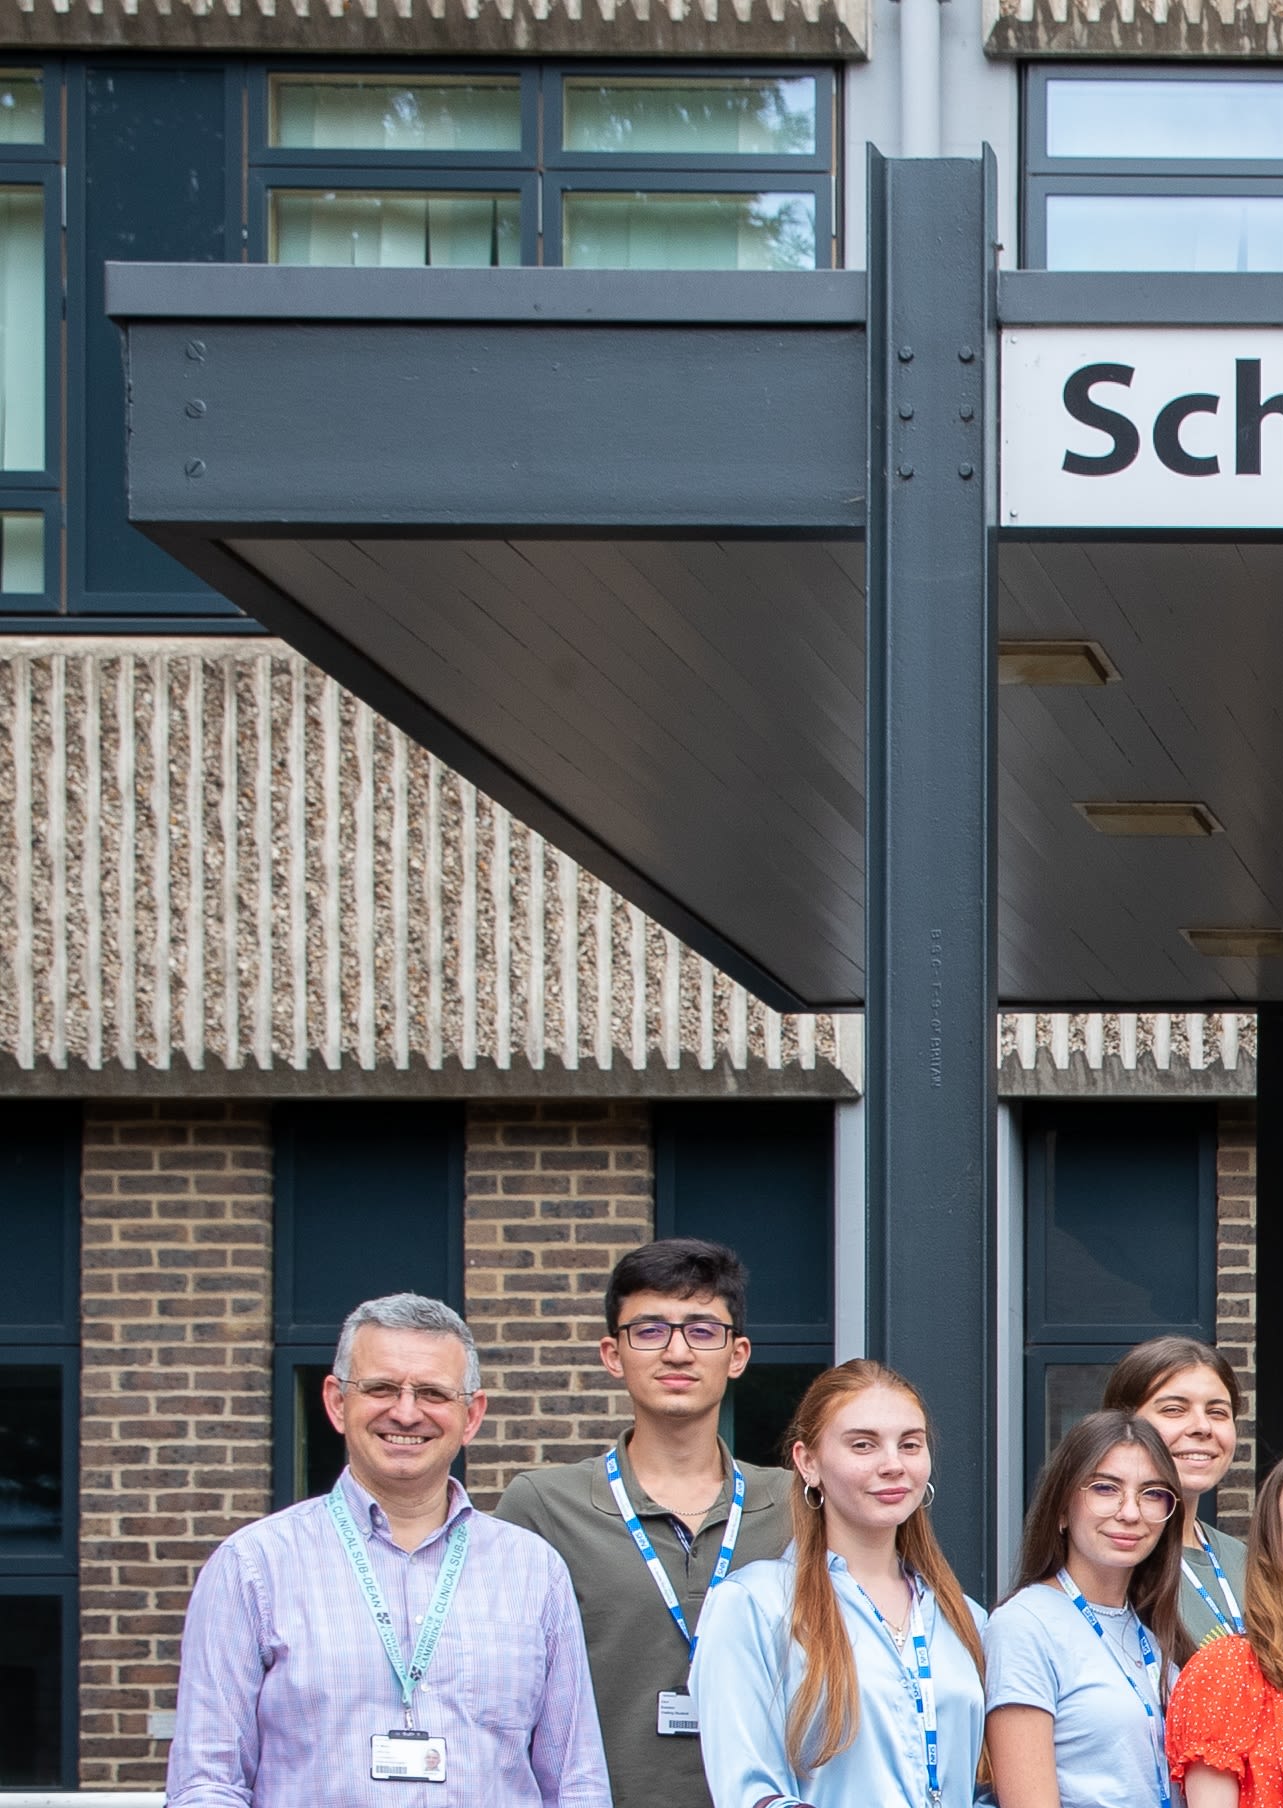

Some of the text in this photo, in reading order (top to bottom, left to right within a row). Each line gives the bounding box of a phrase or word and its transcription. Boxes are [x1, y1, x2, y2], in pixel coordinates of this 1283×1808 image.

[331, 1504, 359, 1550] CLINICAL
[351, 1550, 382, 1609] SUB-DEAN
[632, 1529, 648, 1548] NHS
[434, 1524, 467, 1614] CLINICAL SUB-DE
[716, 1558, 727, 1576] NHS
[412, 1624, 431, 1666] UNIVERSITY
[419, 1617, 441, 1669] CAMBRIDGE
[928, 1745, 936, 1763] NHS
